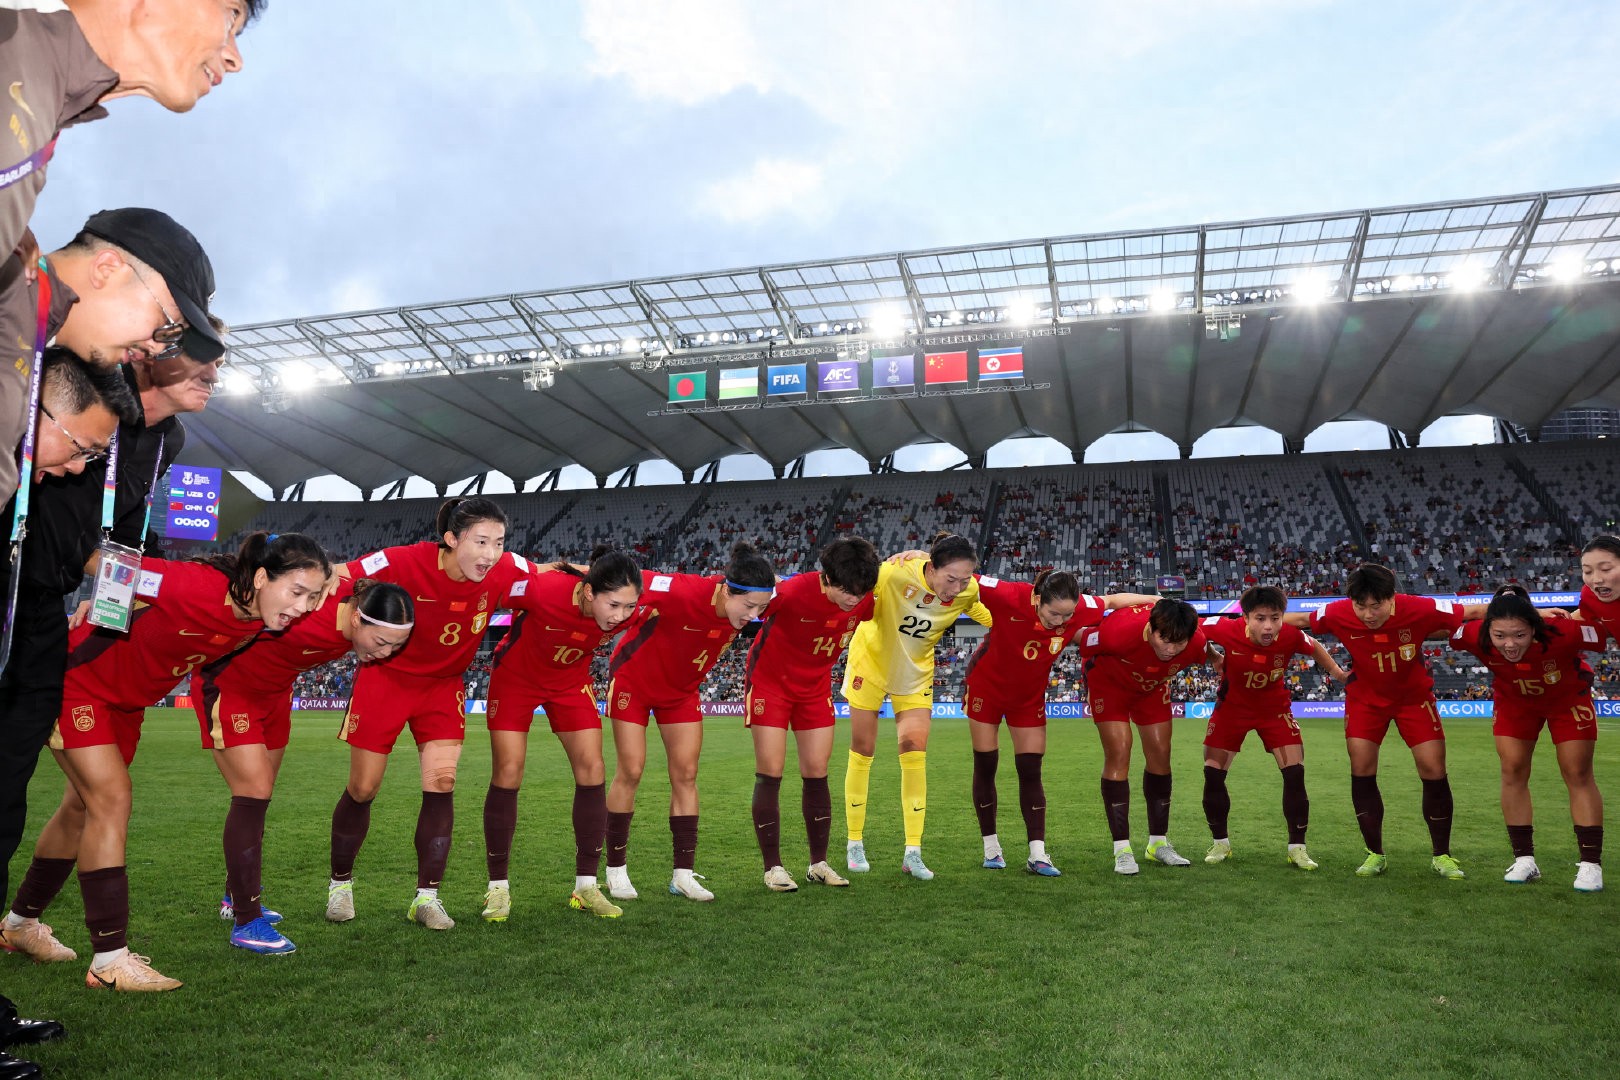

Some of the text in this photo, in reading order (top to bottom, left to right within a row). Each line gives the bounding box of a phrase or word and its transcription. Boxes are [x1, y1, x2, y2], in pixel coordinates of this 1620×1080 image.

[0, 160, 32, 186] EARLESS
[773, 374, 800, 386] FIFA
[823, 367, 852, 381] AFC
[27, 351, 42, 446] DREAM FEARLESS
[107, 454, 116, 480] DREAM
[186, 490, 216, 500] UZB 0
[205, 505, 215, 514] 0
[174, 517, 210, 528] 00:00
[1551, 595, 1575, 603] 2026
[439, 622, 462, 646] 8
[898, 615, 932, 639] 22
[552, 645, 584, 665] 10
[812, 636, 836, 657] 14
[1023, 640, 1041, 661] 6
[172, 654, 207, 677] 3
[692, 649, 709, 671] 4
[1371, 651, 1397, 673] 11
[1243, 671, 1268, 689] 19
[1513, 679, 1545, 696] 15
[300, 700, 328, 709] QATAR
[711, 705, 745, 713] AIRWA
[1171, 704, 1184, 715] YS
[1439, 703, 1485, 715] AGON
